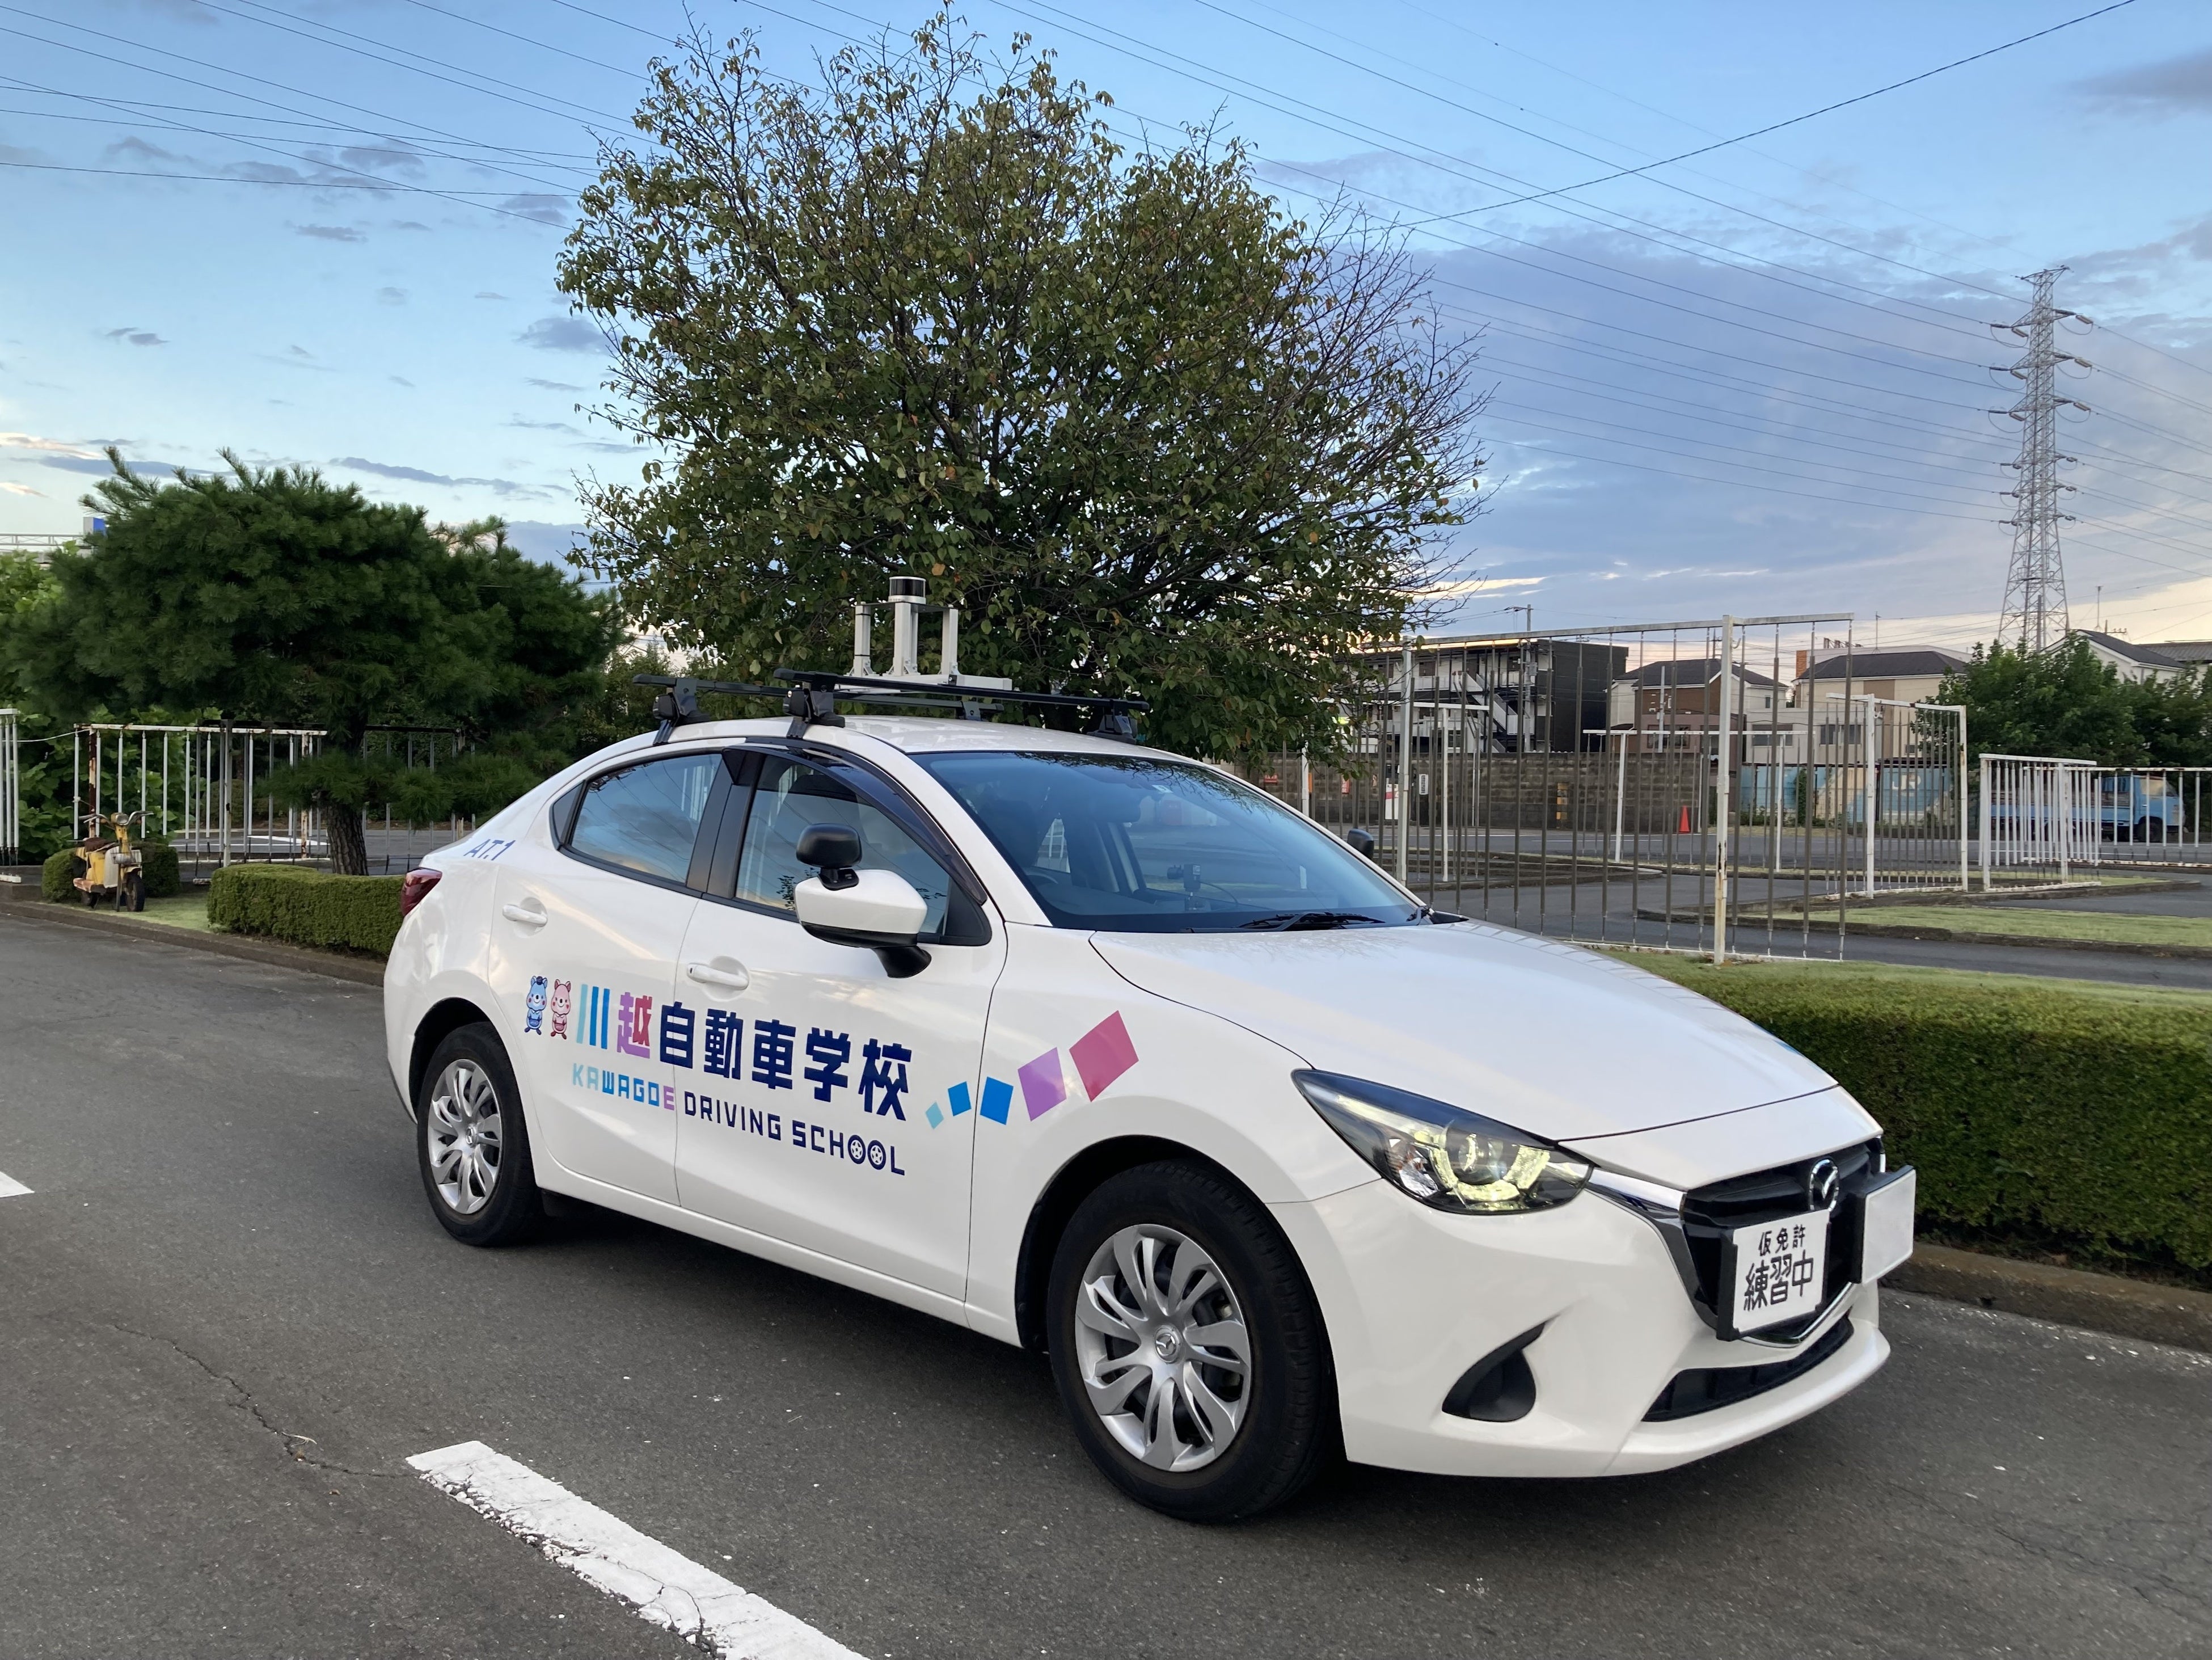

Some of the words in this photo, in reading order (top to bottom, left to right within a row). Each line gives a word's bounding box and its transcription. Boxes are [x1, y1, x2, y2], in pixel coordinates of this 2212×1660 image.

[576, 984, 912, 1121] 川越自動車学校
[573, 1063, 675, 1110] KAWAGOE
[684, 1092, 781, 1141] DRIVING
[792, 1120, 905, 1176] SCHOOL
[1744, 1250, 1814, 1311] 練習中
[1758, 1224, 1806, 1257] 仮免許
